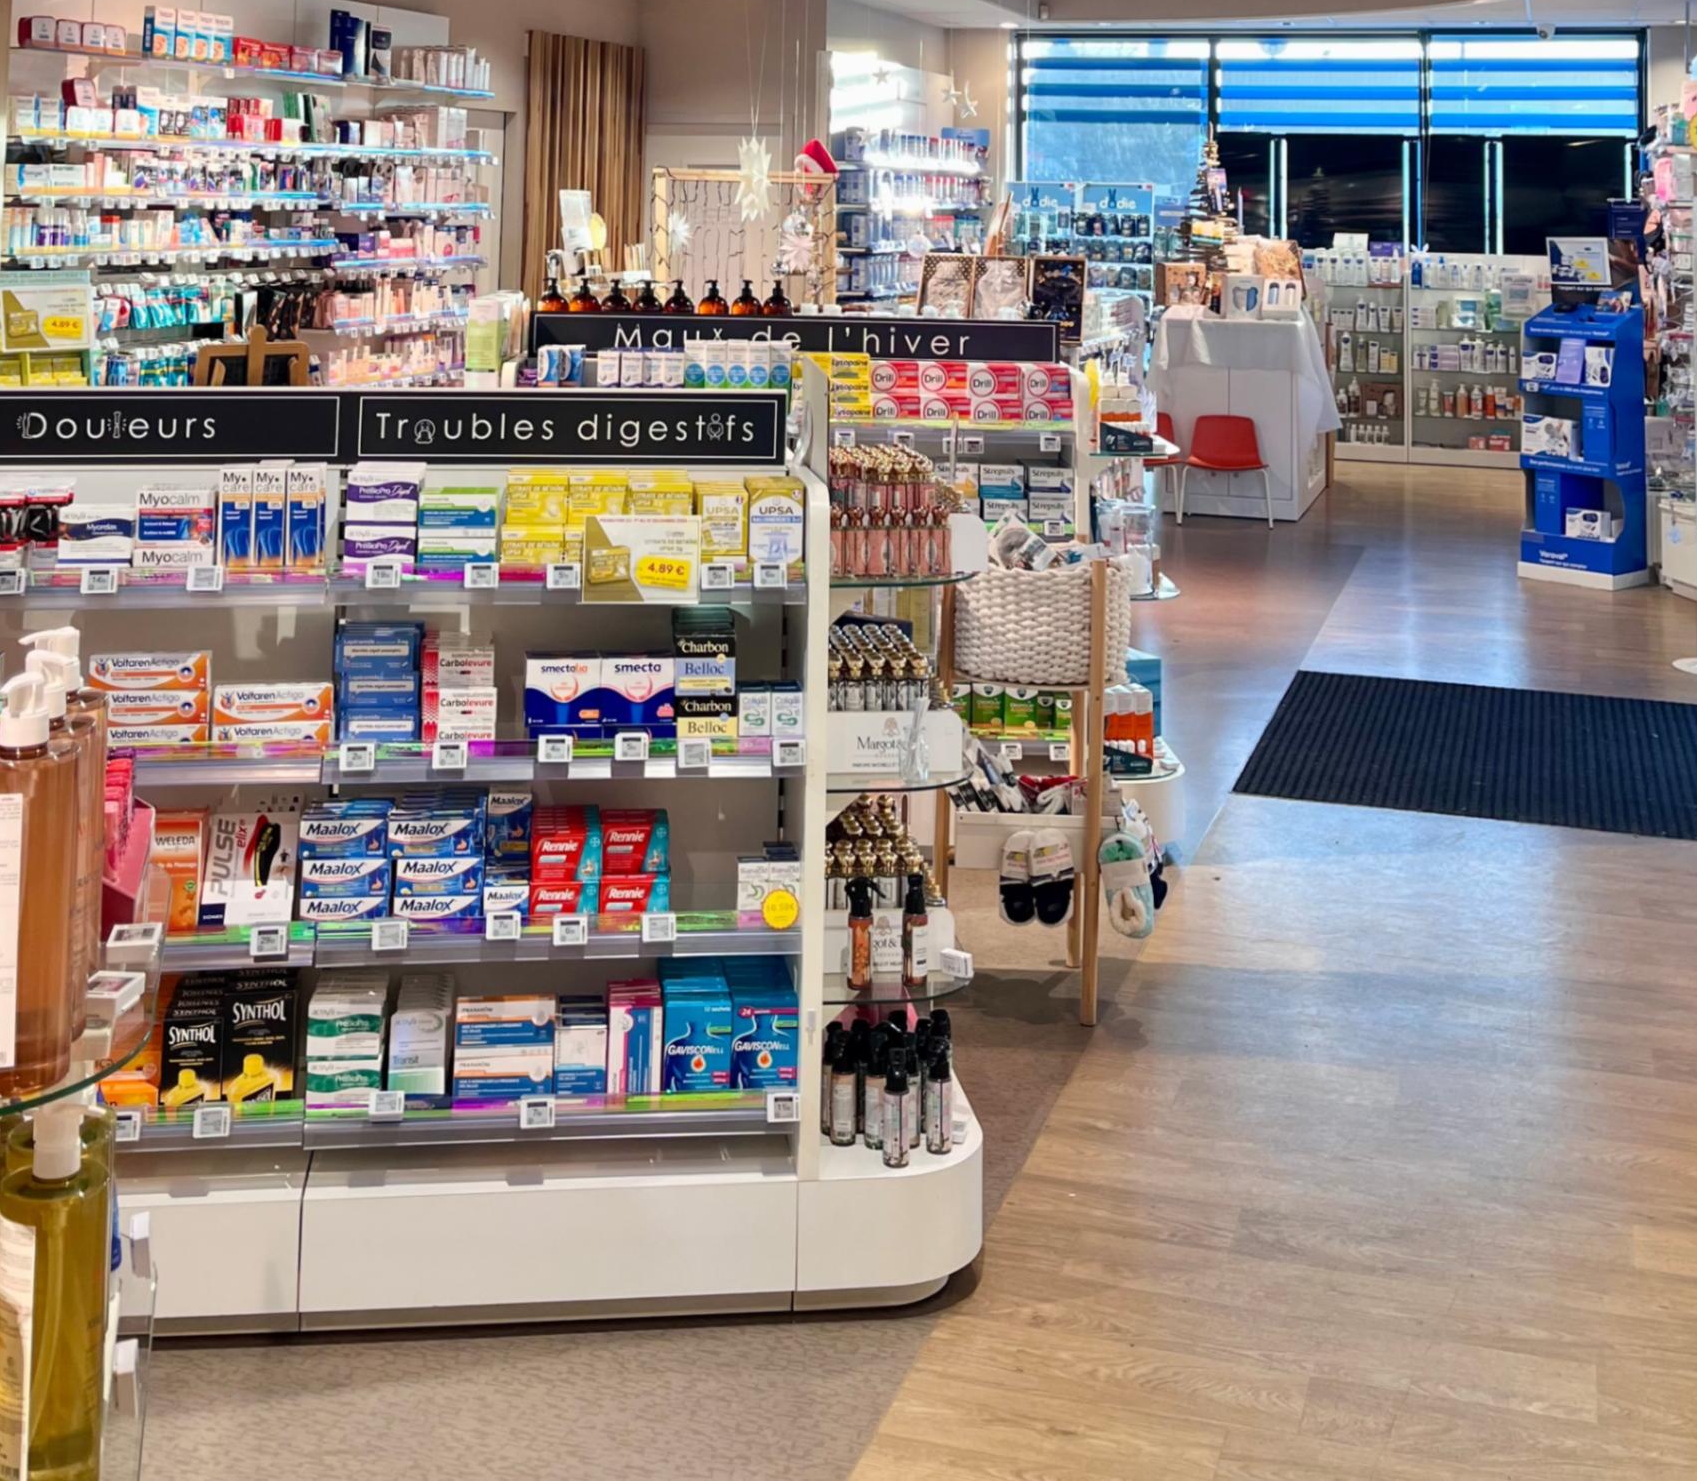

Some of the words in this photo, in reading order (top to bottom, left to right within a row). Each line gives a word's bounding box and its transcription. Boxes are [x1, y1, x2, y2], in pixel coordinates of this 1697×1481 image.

[614, 322, 723, 348] Maux
[752, 325, 801, 350] de
[828, 326, 971, 356] l'hiver
[875, 372, 895, 384] Drill
[924, 373, 944, 384] Drill
[973, 377, 994, 389] Drill
[1029, 377, 1048, 389] Drill
[876, 406, 896, 418] Drill
[926, 406, 947, 418] Drill
[975, 409, 997, 421] Drill
[1029, 409, 1050, 421] Drill
[19, 411, 216, 439] Douleurs
[376, 412, 554, 443] Troubles
[577, 413, 754, 447] digestifs
[139, 493, 200, 507] Myocalm
[706, 506, 739, 514] UPSA
[759, 506, 793, 515] UPSA
[142, 551, 203, 565] Myocalm
[648, 562, 674, 574] 4.89
[676, 566, 685, 576] €
[682, 640, 729, 654] Charbon
[440, 658, 493, 668] Carbolevure
[615, 662, 662, 673] smecta
[685, 662, 725, 675] Belloc
[440, 699, 494, 708] Carbolevure
[683, 700, 731, 713] Charbon
[688, 721, 727, 734] Belloc
[439, 731, 492, 741] Carbolevure
[856, 735, 896, 753] Margot
[306, 822, 361, 836] Maalox
[394, 821, 449, 836] Maalox
[156, 836, 196, 846] WELEDA
[609, 830, 646, 844] Rennie
[541, 840, 579, 853] Rennie
[211, 818, 236, 895] PULSE
[309, 862, 365, 876] Maalox
[402, 861, 458, 874] Maalox
[487, 891, 524, 901] Maalox
[537, 889, 575, 902] Rennie
[609, 887, 645, 900] Rennie
[306, 900, 362, 914] Maalox
[399, 899, 455, 912] Maalox
[232, 1000, 287, 1023] SYNTHOL
[168, 1025, 216, 1045] SYNTHOL
